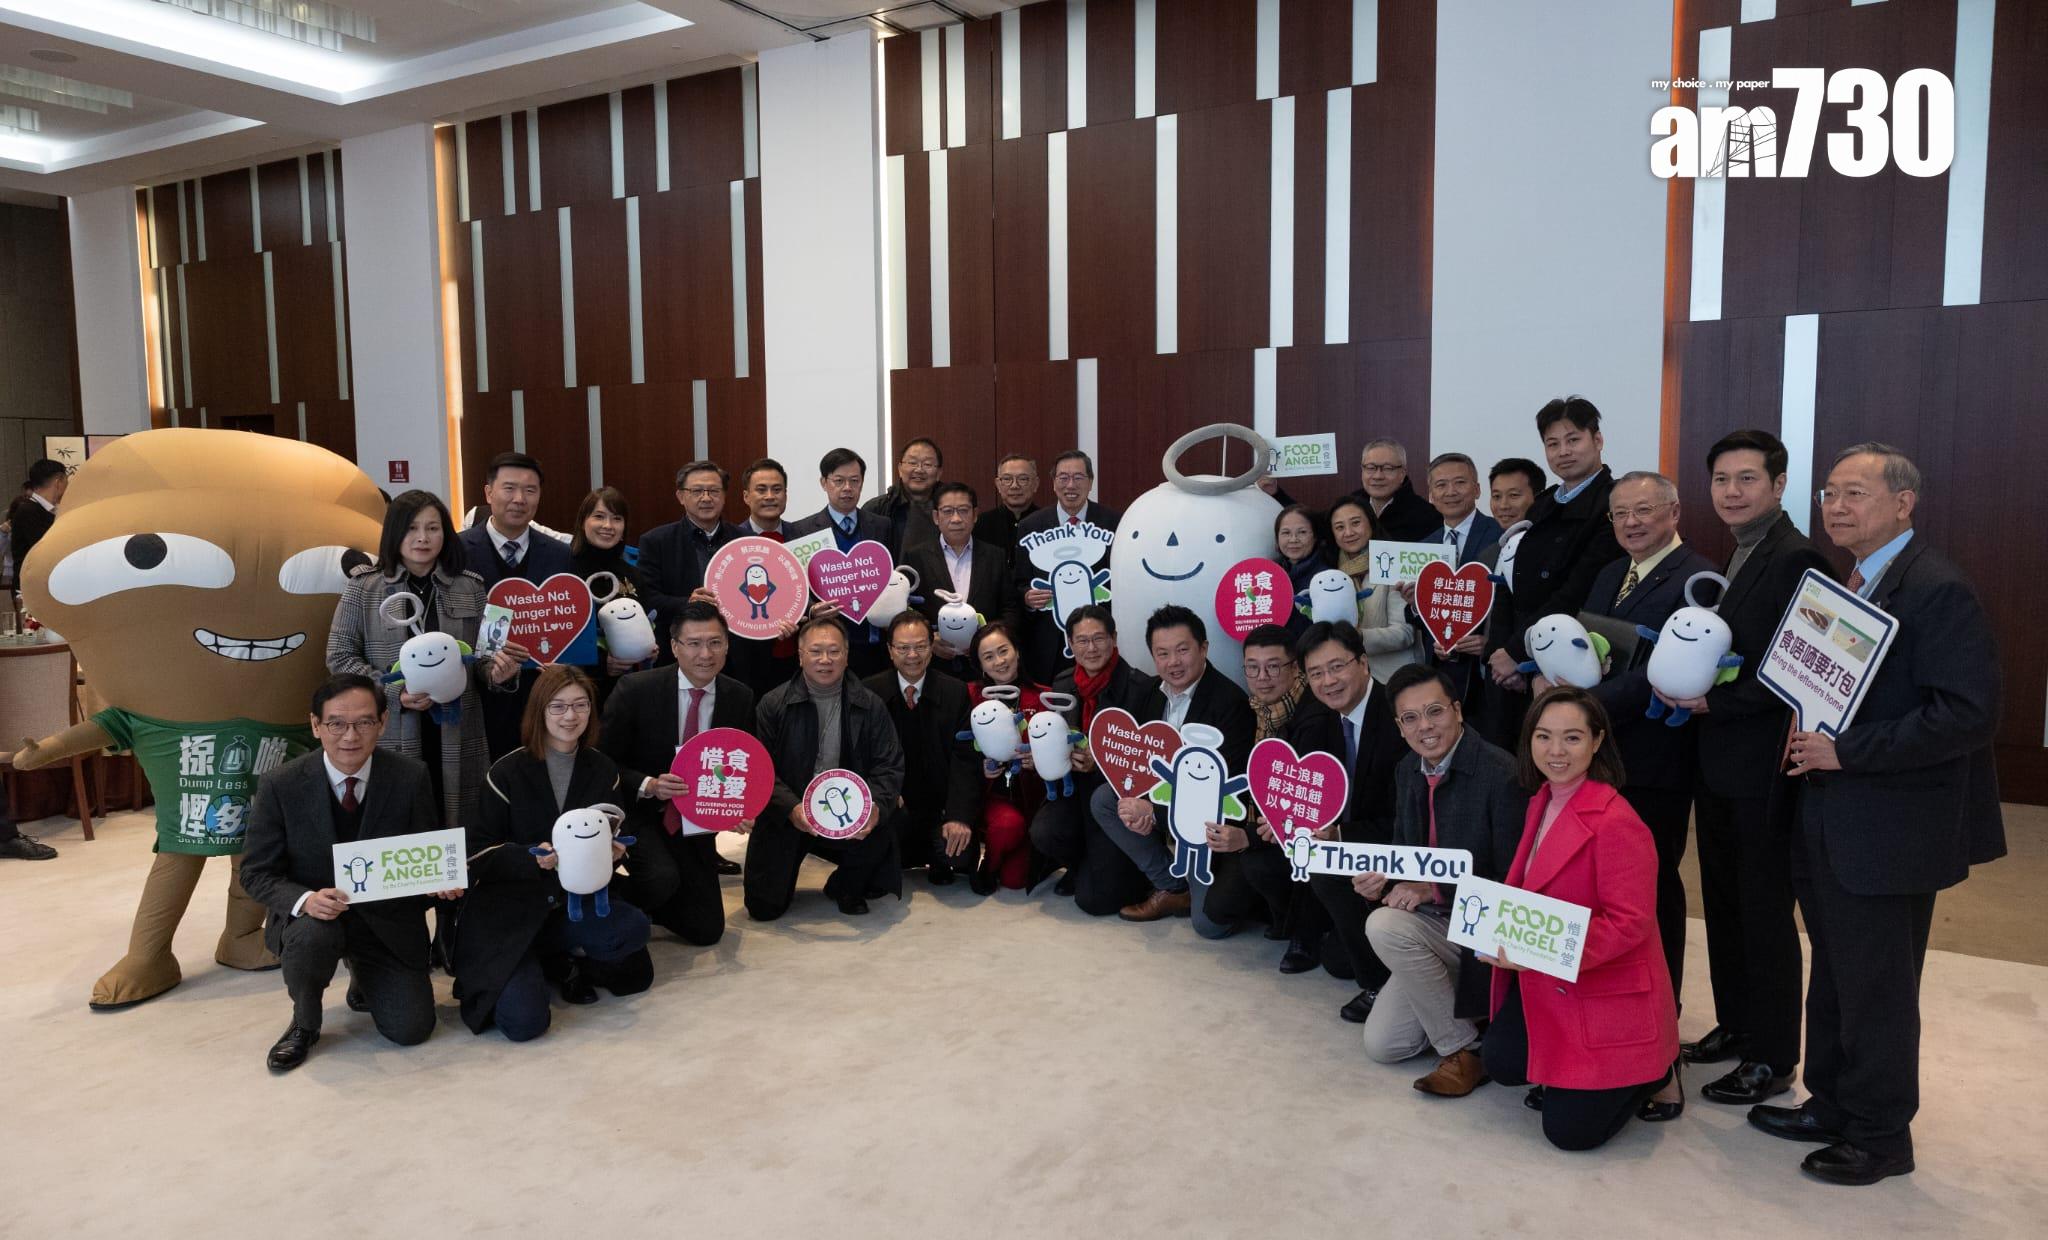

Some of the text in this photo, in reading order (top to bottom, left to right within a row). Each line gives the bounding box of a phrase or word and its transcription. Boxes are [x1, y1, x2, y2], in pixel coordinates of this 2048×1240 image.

[1284, 444, 1321, 456] FOOD
[1285, 456, 1322, 466] ANGEL
[1022, 524, 1113, 551] Thank You
[794, 541, 821, 557] OOD
[820, 556, 874, 573] Waste Not
[820, 567, 880, 585] Hunger Not
[1235, 571, 1273, 593] 惜食
[1433, 577, 1476, 592] 停止浪費
[504, 590, 570, 606] Waste Not
[827, 587, 851, 598] With
[511, 604, 577, 620] unger Not
[511, 622, 540, 636] With
[1771, 650, 1844, 712] Bring the leftovers home
[1107, 722, 1165, 749] Waste Not
[1102, 736, 1144, 756] Hunger
[700, 746, 750, 773] 惜食
[1105, 752, 1130, 768] With
[1272, 759, 1325, 788] 停止浪費
[180, 778, 248, 790] Dump Less
[1267, 775, 1323, 805] 解決飢餓
[180, 793, 255, 838] 慳多
[721, 809, 744, 817] LOVE
[381, 845, 443, 868] FOOD
[1321, 846, 1466, 878] Thank You
[383, 863, 443, 882] ANGEL
[1498, 900, 1565, 936] FOOD
[1494, 921, 1559, 954] ANGEL
